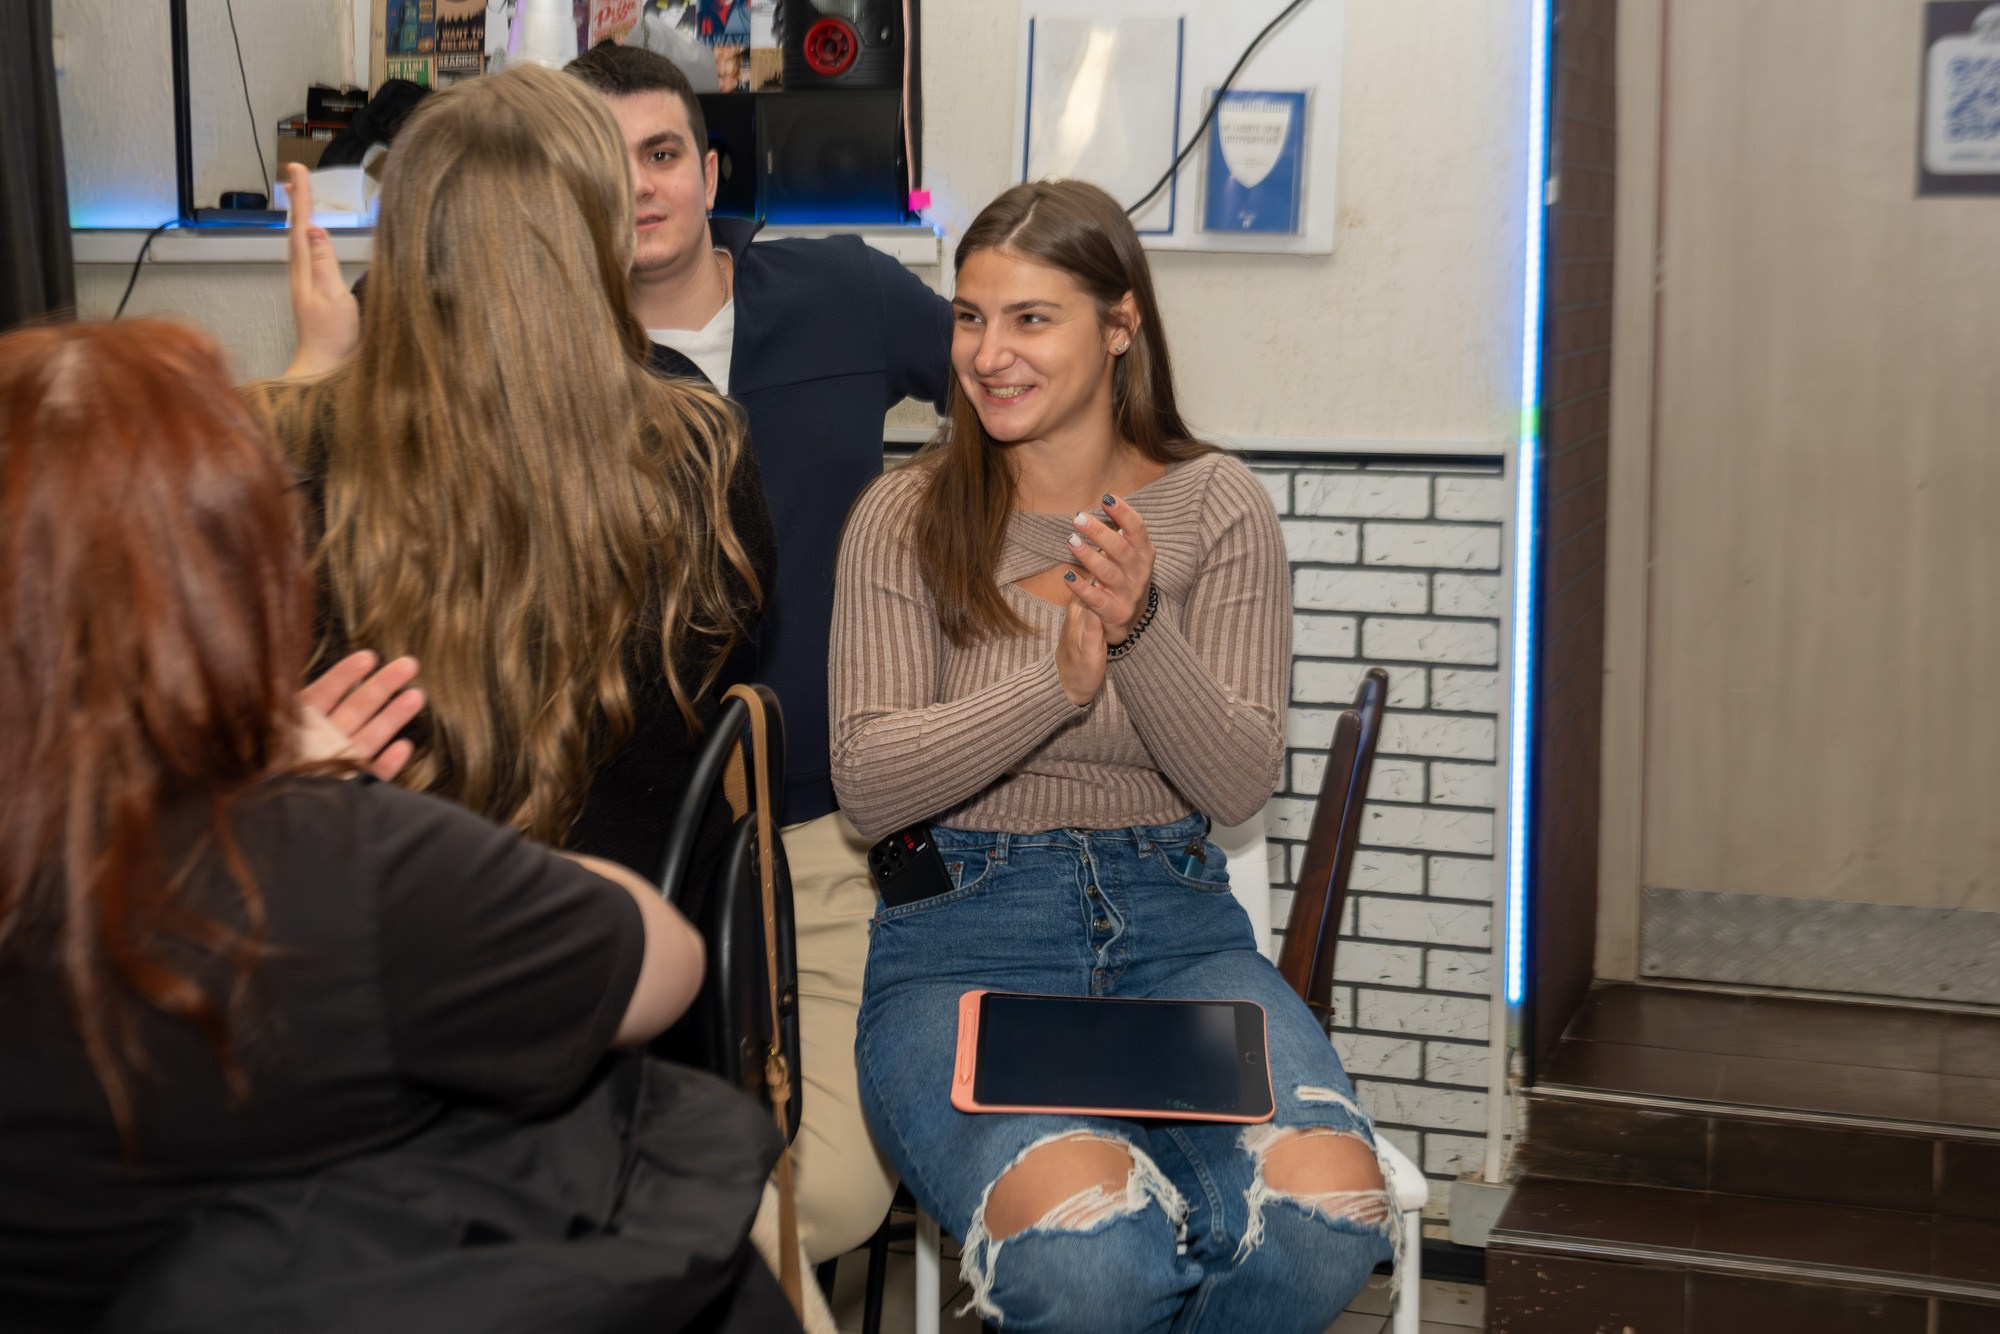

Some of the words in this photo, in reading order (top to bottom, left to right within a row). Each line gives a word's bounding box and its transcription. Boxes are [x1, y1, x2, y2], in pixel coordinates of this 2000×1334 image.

[442, 27, 468, 40] WANT
[471, 27, 484, 40] TO
[440, 40, 479, 52] BELIEVE
[437, 55, 480, 69] READING
